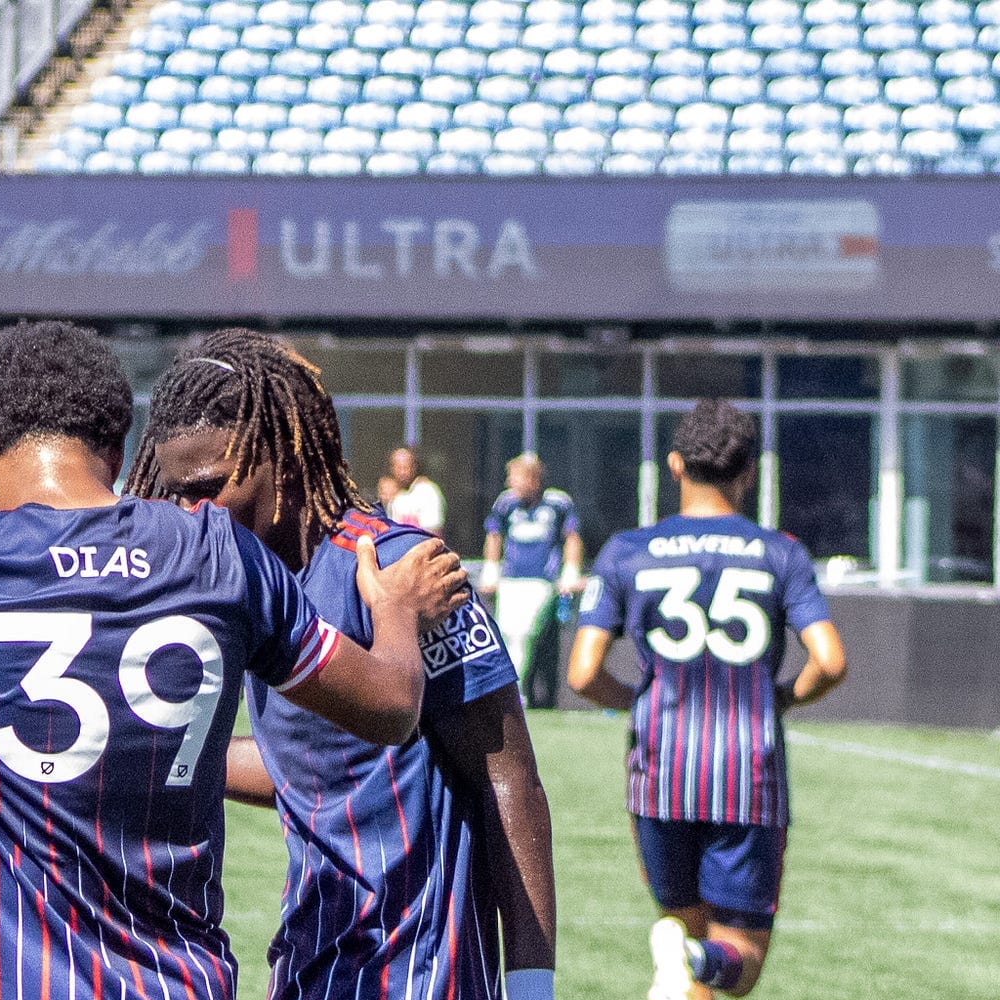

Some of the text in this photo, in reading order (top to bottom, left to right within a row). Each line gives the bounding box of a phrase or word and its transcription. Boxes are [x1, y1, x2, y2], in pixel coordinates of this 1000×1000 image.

[280, 217, 541, 280] ULTRA
[49, 546, 150, 578] DIAS
[635, 567, 774, 664] 35
[444, 623, 491, 657] PRO
